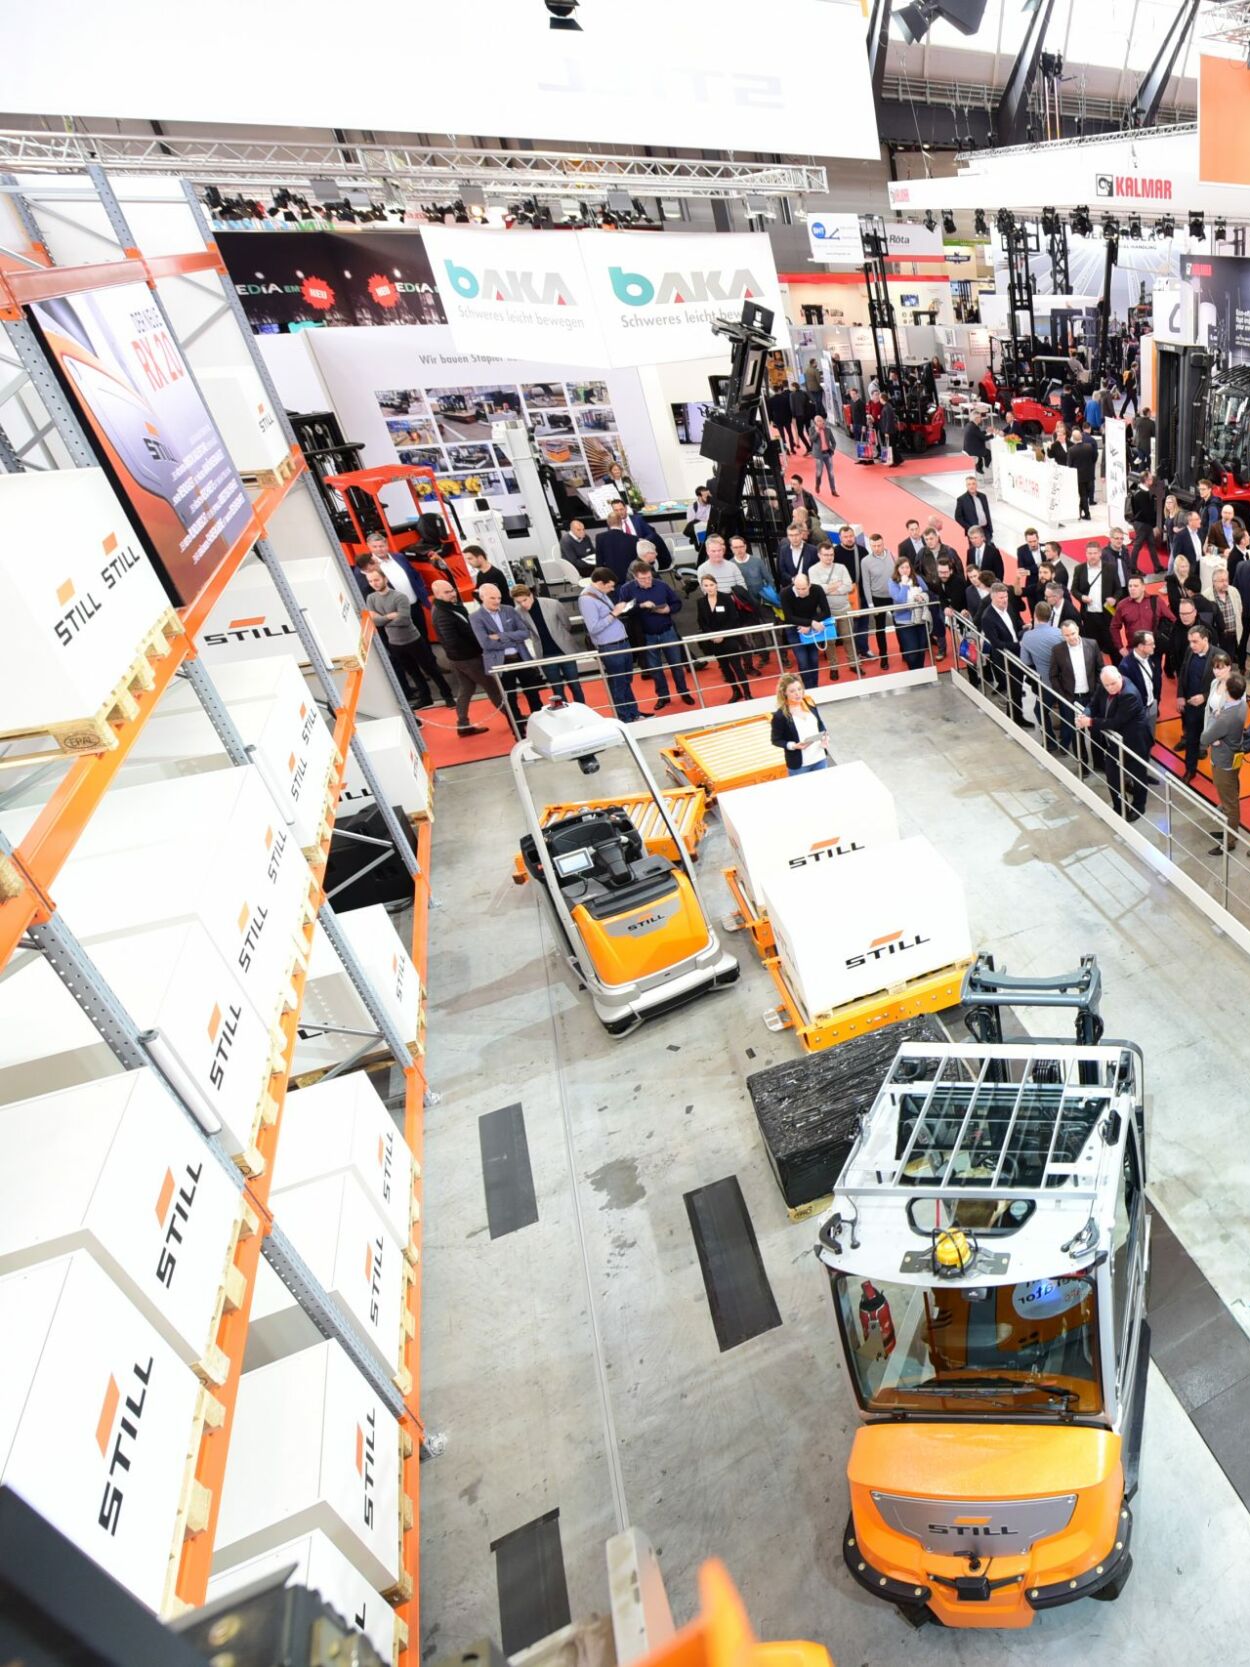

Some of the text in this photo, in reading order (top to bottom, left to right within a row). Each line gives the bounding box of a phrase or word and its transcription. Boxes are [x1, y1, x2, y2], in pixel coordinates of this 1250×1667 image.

[1115, 176, 1172, 200] KALMAR
[458, 305, 585, 331] Schweres leicht bewegen
[621, 312, 682, 328] Schweres
[686, 309, 718, 324] leicht
[131, 331, 185, 392] RX 20
[419, 354, 438, 365] Wir
[441, 354, 469, 365] bauen
[258, 413, 275, 433] STILL
[143, 437, 179, 463] STILL
[100, 546, 141, 589] STILL
[54, 592, 103, 647] STILL
[203, 623, 299, 646] STILL
[301, 709, 317, 746] STILL
[290, 757, 308, 802] STILL
[267, 830, 288, 885] STILL
[788, 841, 866, 870] STILL
[238, 905, 268, 974] STILL
[627, 913, 668, 932] STILL
[844, 934, 931, 970] STILL
[209, 1003, 242, 1091] STILL
[382, 1131, 394, 1205] STILL
[155, 1162, 203, 1290] STILL
[370, 1235, 384, 1328] STILL
[98, 1356, 154, 1537] STILL
[363, 1407, 376, 1531] STILL
[928, 1523, 1019, 1537] STILL
